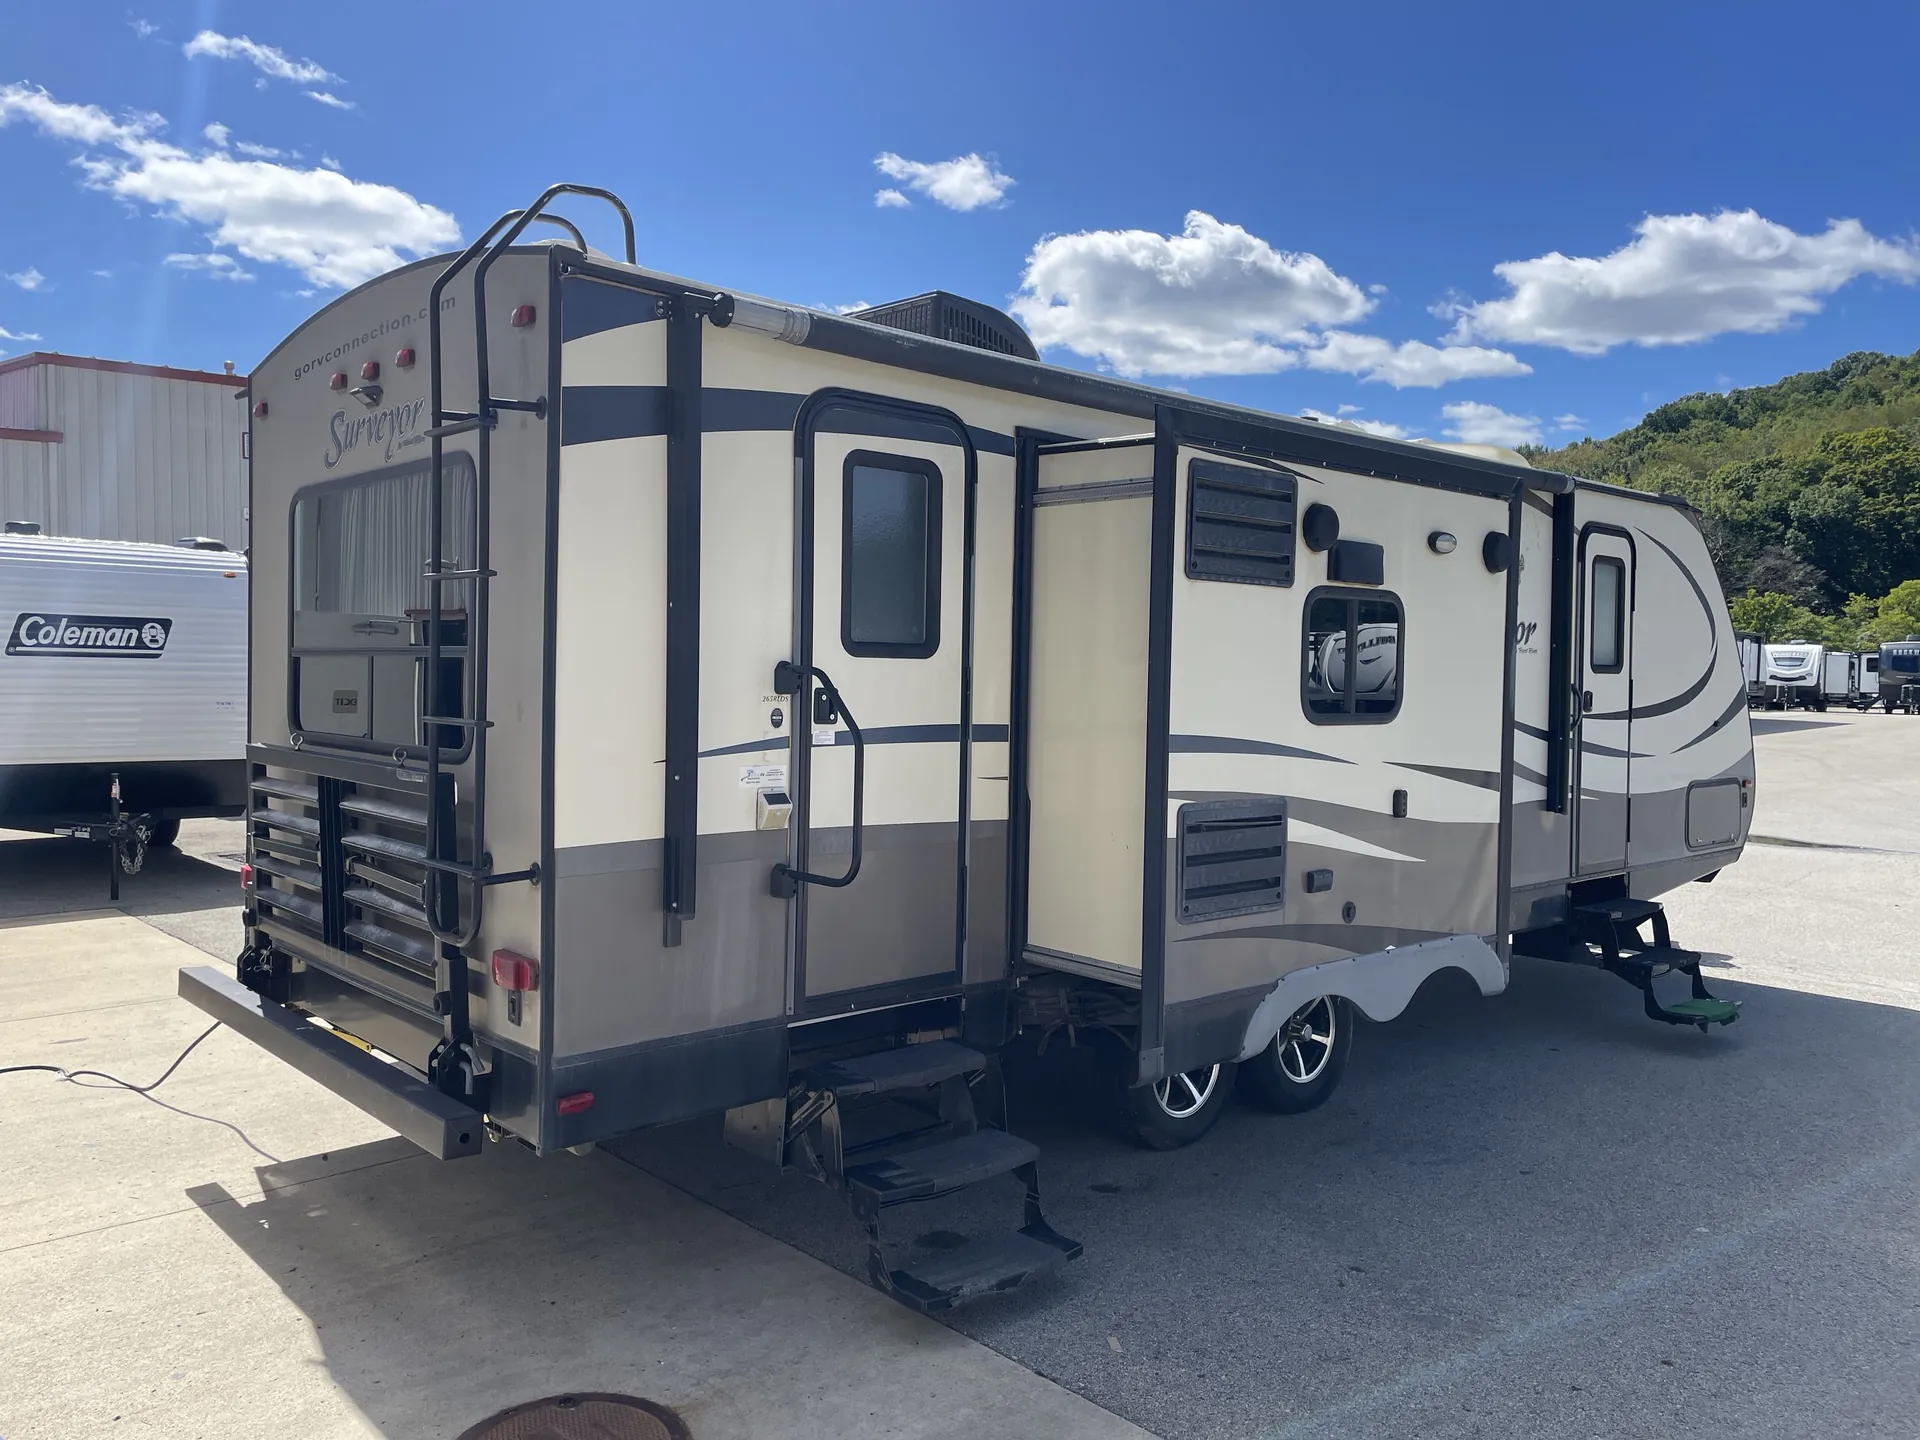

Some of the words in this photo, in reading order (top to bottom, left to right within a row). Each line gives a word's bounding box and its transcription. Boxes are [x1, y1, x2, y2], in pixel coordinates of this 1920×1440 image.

[293, 296, 457, 381] gorvconnection.cm
[324, 397, 425, 469] Surveyor
[19, 615, 140, 647] Coleman
